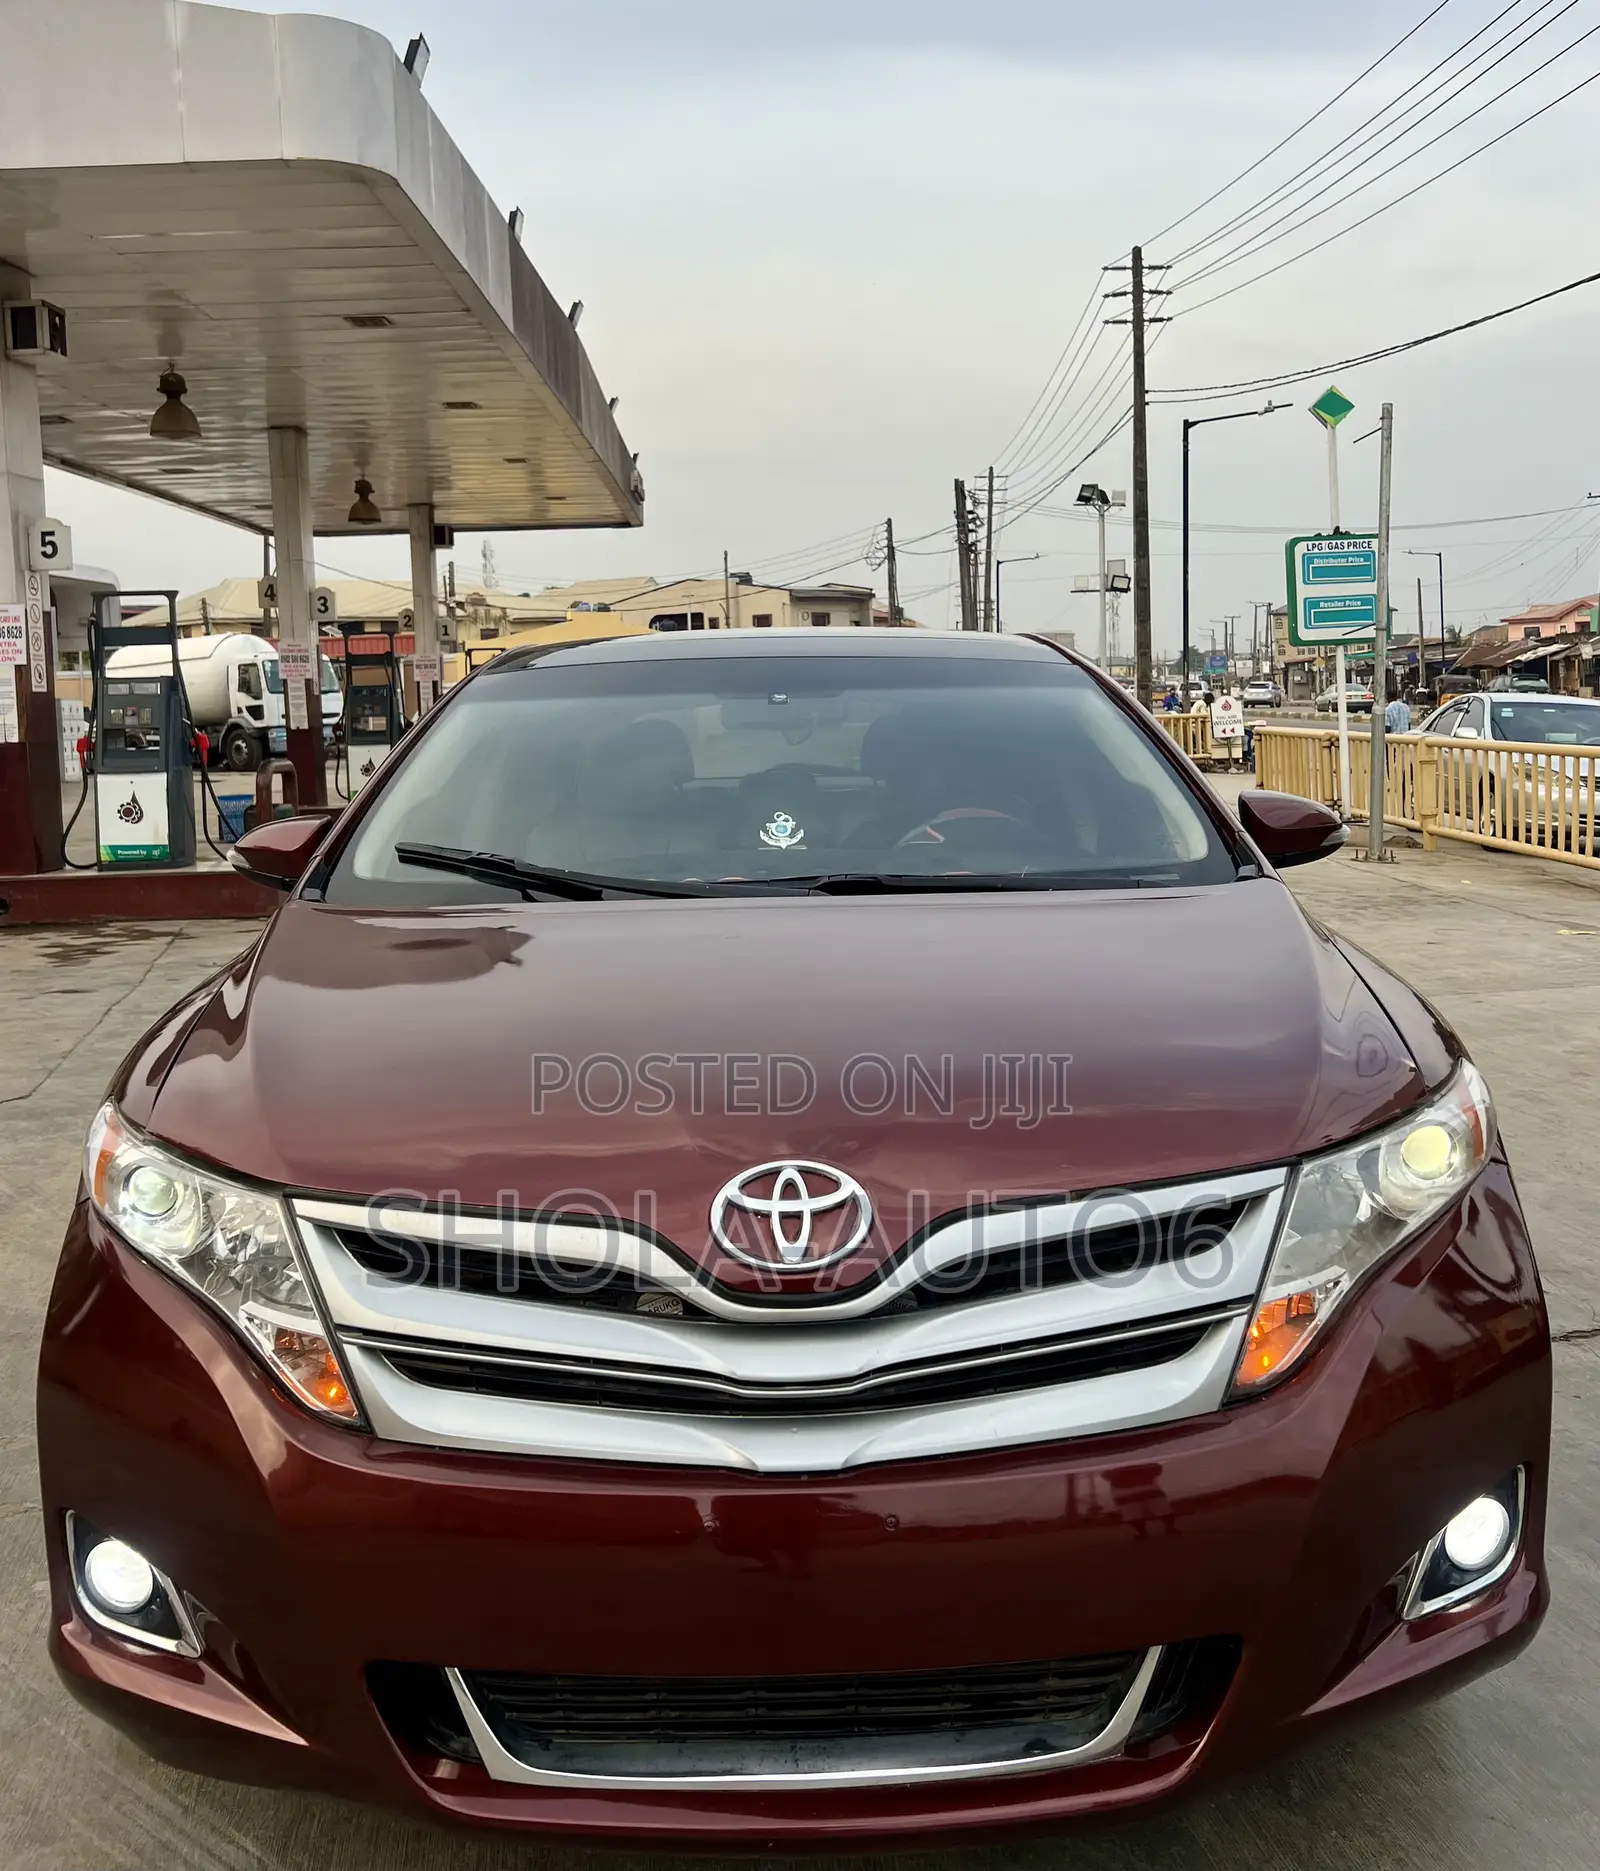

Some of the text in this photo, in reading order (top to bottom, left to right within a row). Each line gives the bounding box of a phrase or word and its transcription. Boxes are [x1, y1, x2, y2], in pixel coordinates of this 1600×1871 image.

[40, 531, 59, 559] 5
[1306, 540, 1373, 552] LPG/GAS PRICE
[264, 583, 277, 602] 4
[317, 596, 329, 614] 3
[403, 614, 412, 628] 2
[7, 625, 23, 639] 8628
[442, 625, 450, 637] 1
